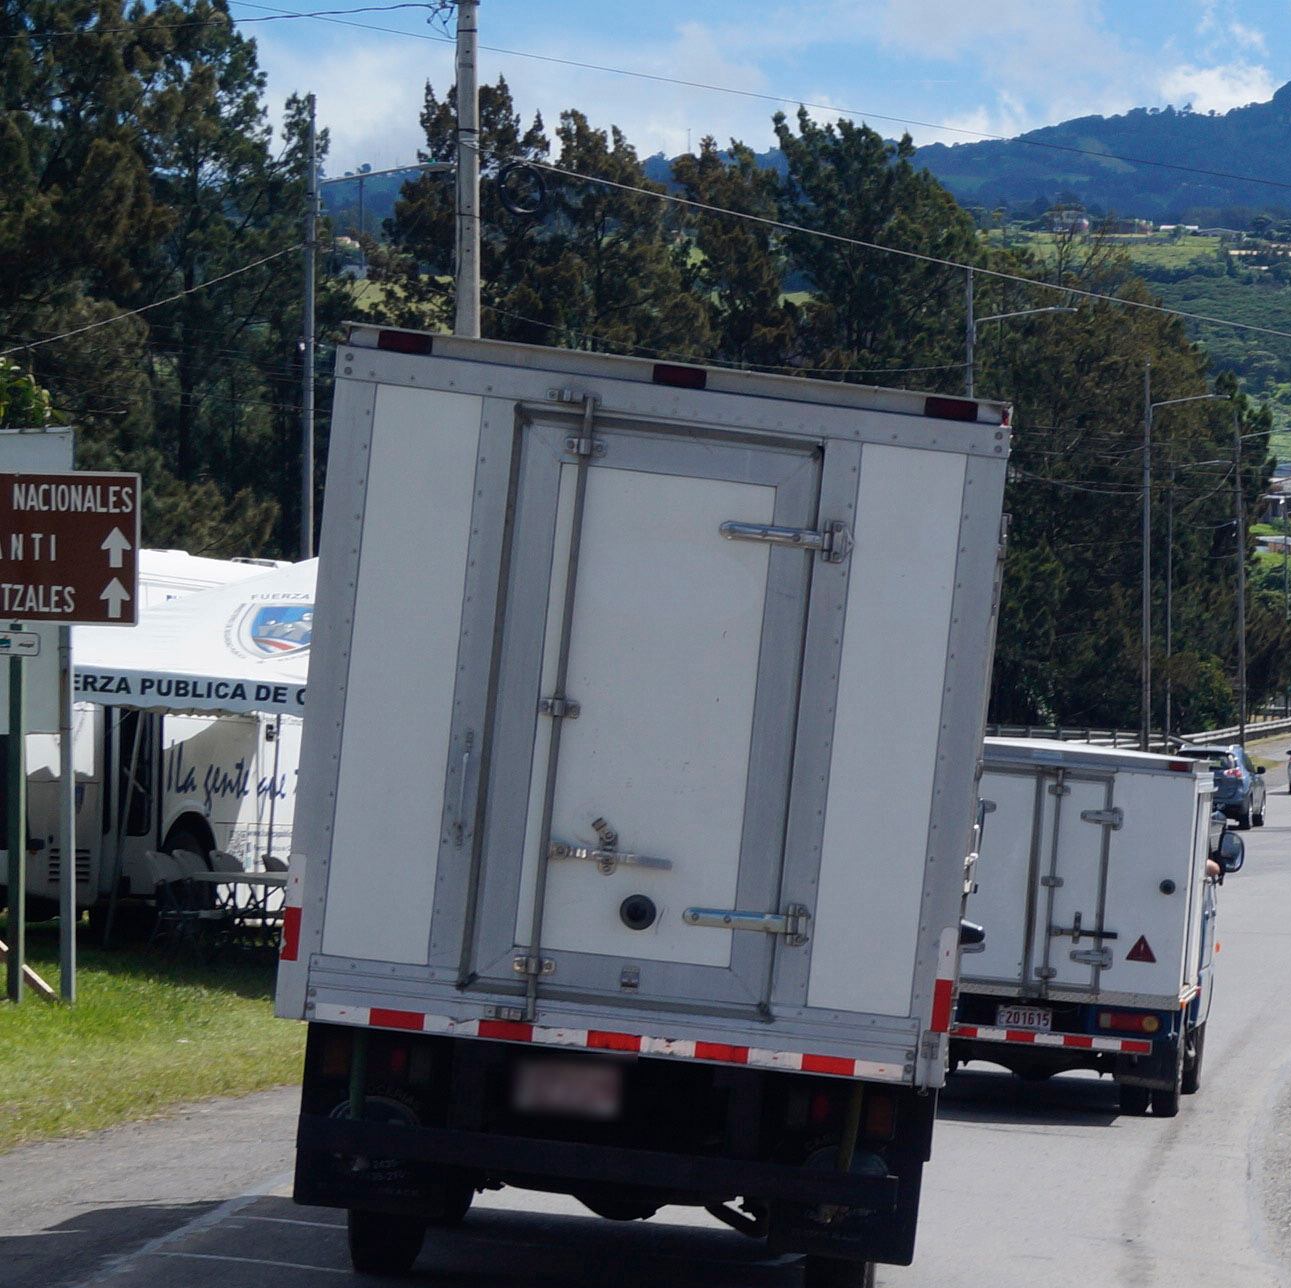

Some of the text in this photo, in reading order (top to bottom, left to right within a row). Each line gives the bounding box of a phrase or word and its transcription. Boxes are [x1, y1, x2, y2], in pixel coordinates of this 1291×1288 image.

[12, 483, 133, 513] NACIONALES
[140, 678, 247, 700] PUBLICA
[254, 684, 288, 704] DE
